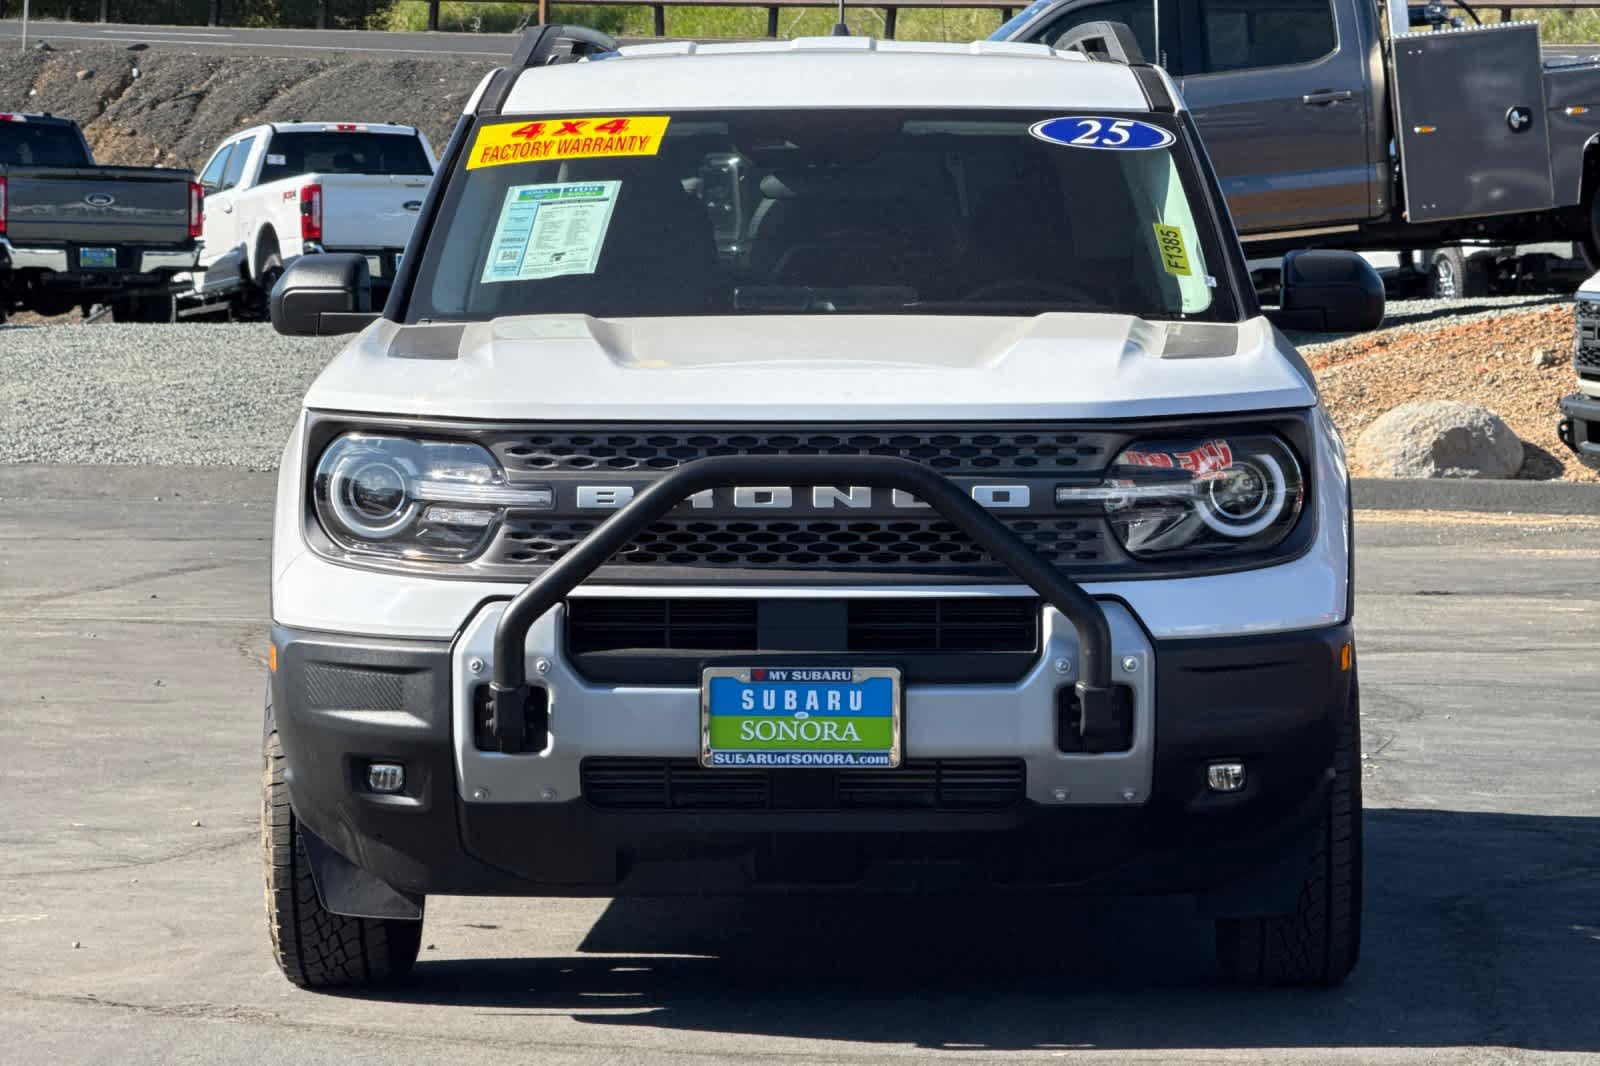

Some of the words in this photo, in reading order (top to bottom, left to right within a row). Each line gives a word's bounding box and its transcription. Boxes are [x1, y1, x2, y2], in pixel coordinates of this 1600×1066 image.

[1070, 119, 1134, 145] 25
[480, 140, 552, 163] FACTORY
[556, 135, 649, 154] WARRANTY
[1160, 229, 1187, 269] F1385
[769, 671, 788, 681] MY
[792, 671, 851, 681] SUBARU
[741, 689, 862, 711] SUBARU
[740, 720, 862, 742] SONORA
[714, 752, 889, 765] SUBARUofSONORA.com
